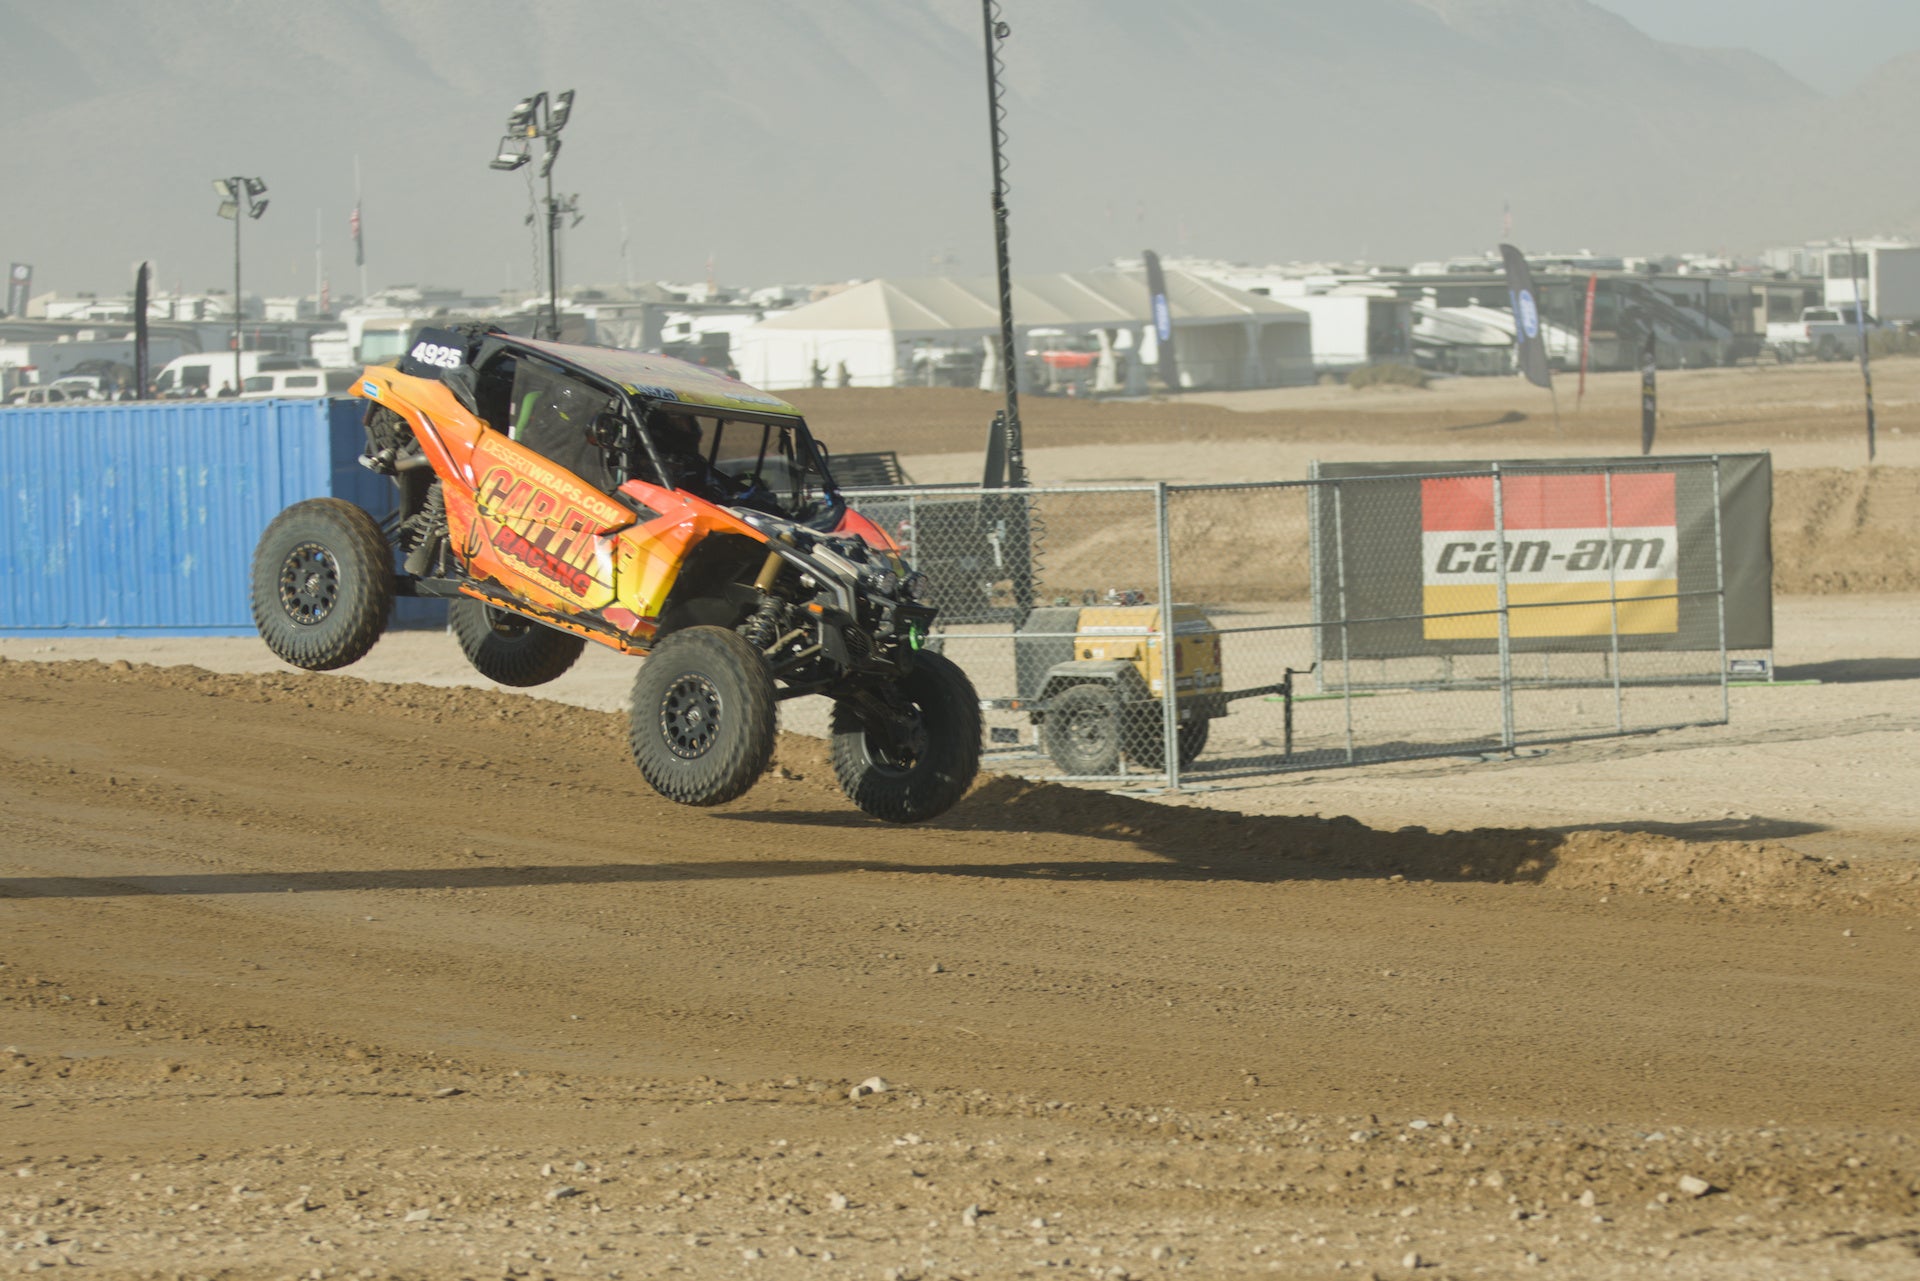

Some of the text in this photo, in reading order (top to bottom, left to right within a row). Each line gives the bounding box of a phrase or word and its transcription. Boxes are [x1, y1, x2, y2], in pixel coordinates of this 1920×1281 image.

[411, 341, 462, 369] 4925
[482, 438, 620, 524] DESERTWRAPS.COM
[493, 525, 592, 598] RACING
[1436, 537, 1665, 574] can-am
